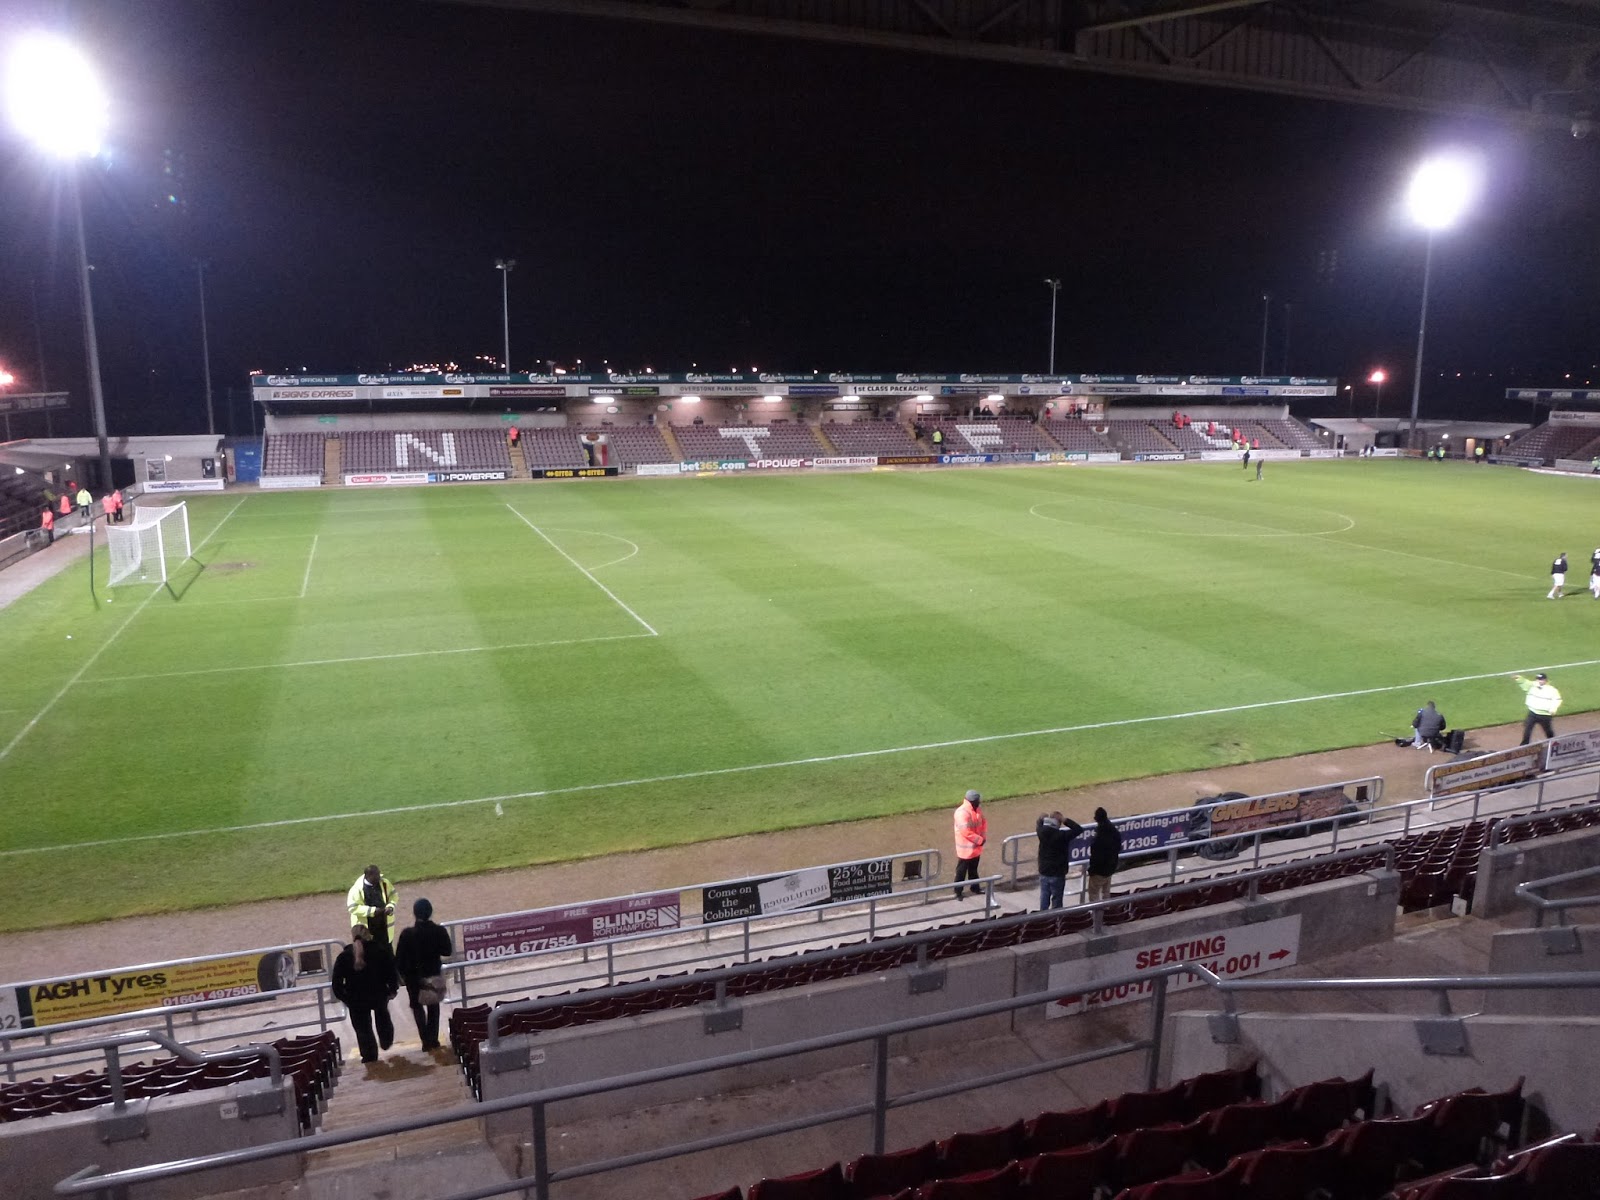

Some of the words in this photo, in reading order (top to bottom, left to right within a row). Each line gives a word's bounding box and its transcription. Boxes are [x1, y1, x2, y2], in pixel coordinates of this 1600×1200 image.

[267, 375, 299, 386] Carlsberg
[358, 375, 389, 385] Carlsberg
[445, 374, 475, 384] Carlsberg
[529, 374, 557, 383] Carlsberg
[610, 373, 637, 383] Carlsberg
[686, 373, 712, 383] Carlsberg
[759, 373, 784, 383] Carlsberg
[281, 391, 309, 399] SIGNS
[311, 390, 354, 398] EXPRESS
[1035, 452, 1086, 461] bet365.com
[681, 461, 745, 471] bet365.com
[757, 459, 804, 468] npower
[450, 472, 505, 480] POWERADE
[833, 865, 863, 880] 25%
[868, 859, 890, 873] Off
[833, 880, 850, 888] Food
[869, 873, 890, 881] Drink
[707, 888, 738, 901] Come
[739, 886, 752, 894] on
[629, 897, 653, 908] FAST
[722, 897, 739, 907] the
[563, 907, 588, 918] FREE
[704, 905, 756, 920] Cobblers!!
[592, 908, 657, 930] BLINDS
[464, 921, 492, 932] FIRST
[592, 920, 657, 937] NORTHAMPTON
[466, 943, 516, 960] 01604
[520, 934, 578, 953] 677554
[1136, 936, 1225, 969] SEATING
[35, 979, 91, 1003] AGH
[92, 972, 167, 995] Tyres
[163, 992, 205, 1006] 01604
[208, 985, 258, 1000] 497505
